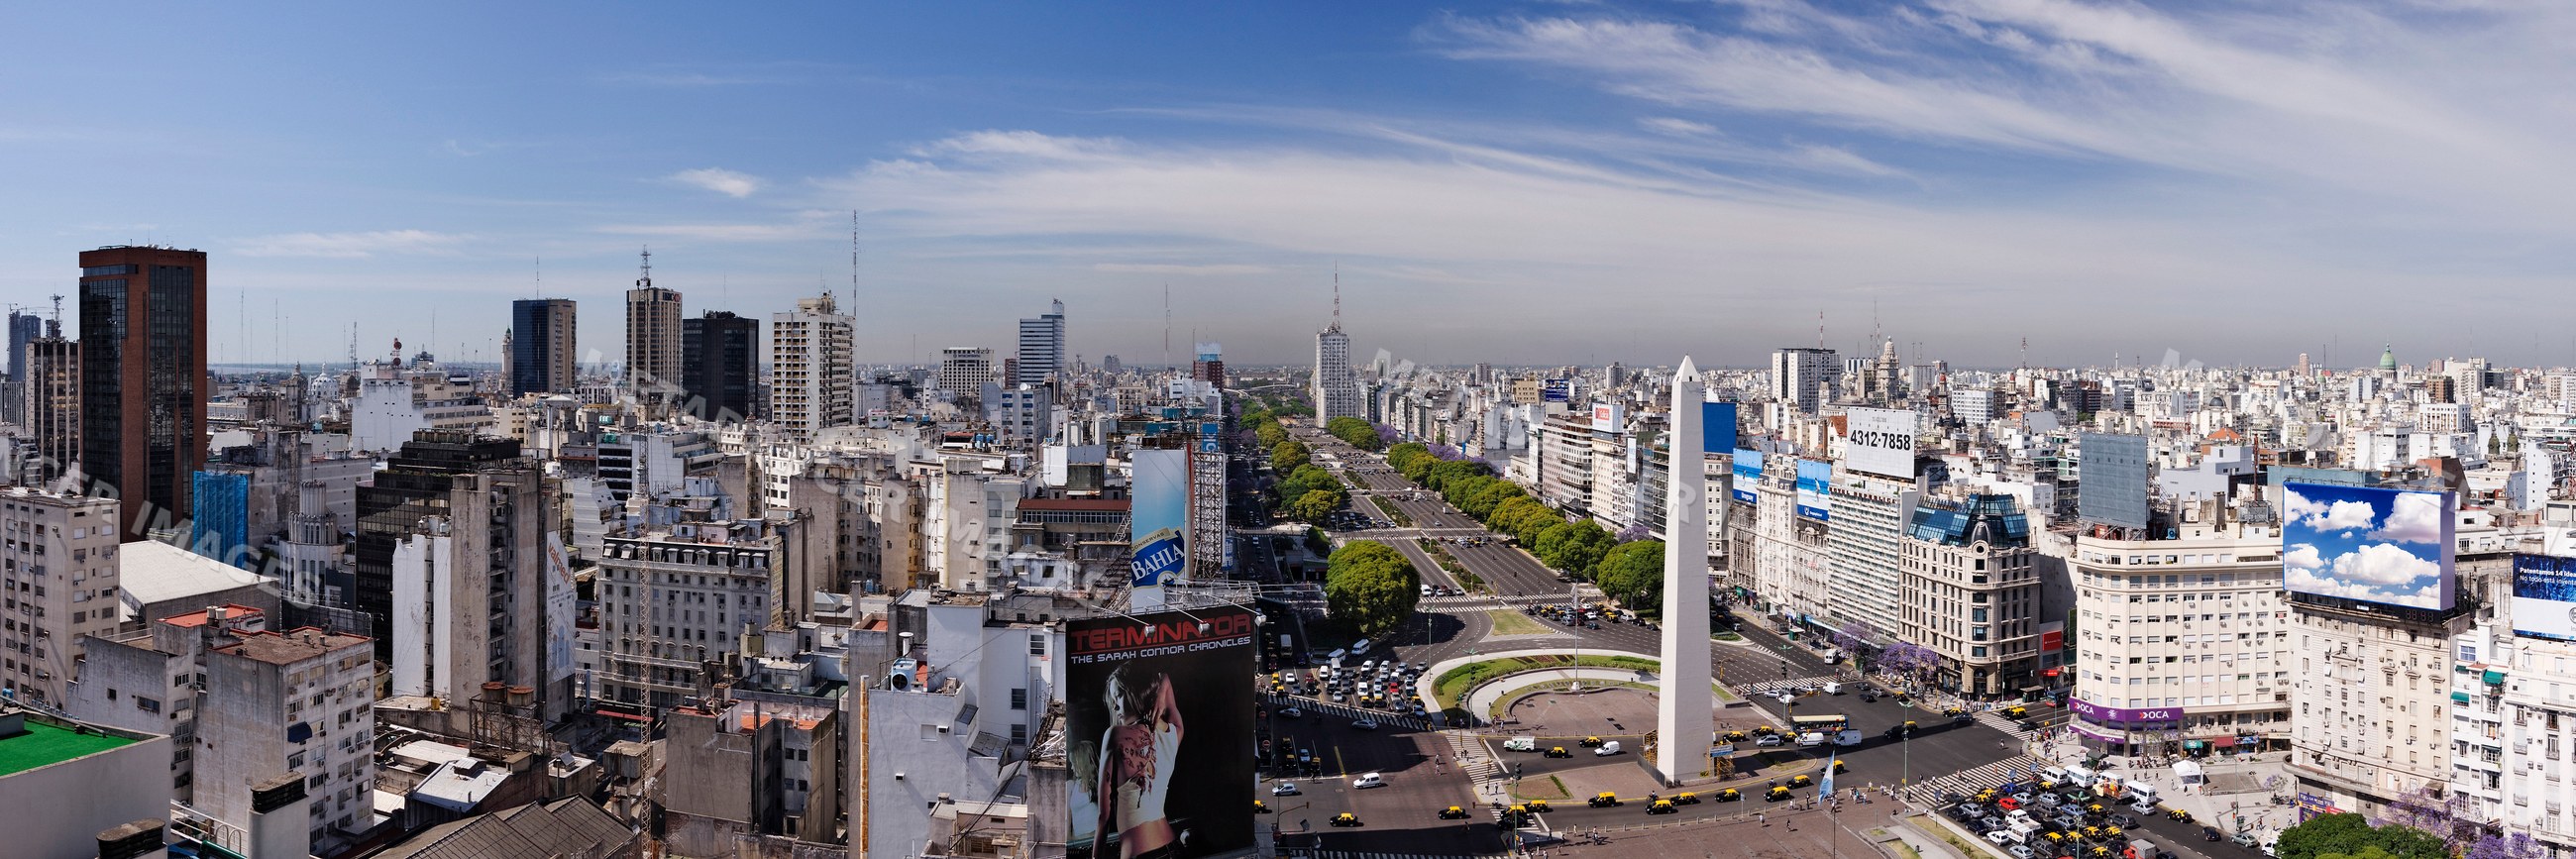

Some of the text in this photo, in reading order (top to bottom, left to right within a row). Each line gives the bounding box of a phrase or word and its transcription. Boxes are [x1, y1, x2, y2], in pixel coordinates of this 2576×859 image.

[1131, 531, 1165, 552] CONSERVAS
[1131, 544, 1185, 582] BAHIA
[1071, 636, 1251, 665] THE SARAH CONNOR CHRONICLES
[2081, 702, 2094, 714] OCA
[2148, 710, 2170, 719] OCA
